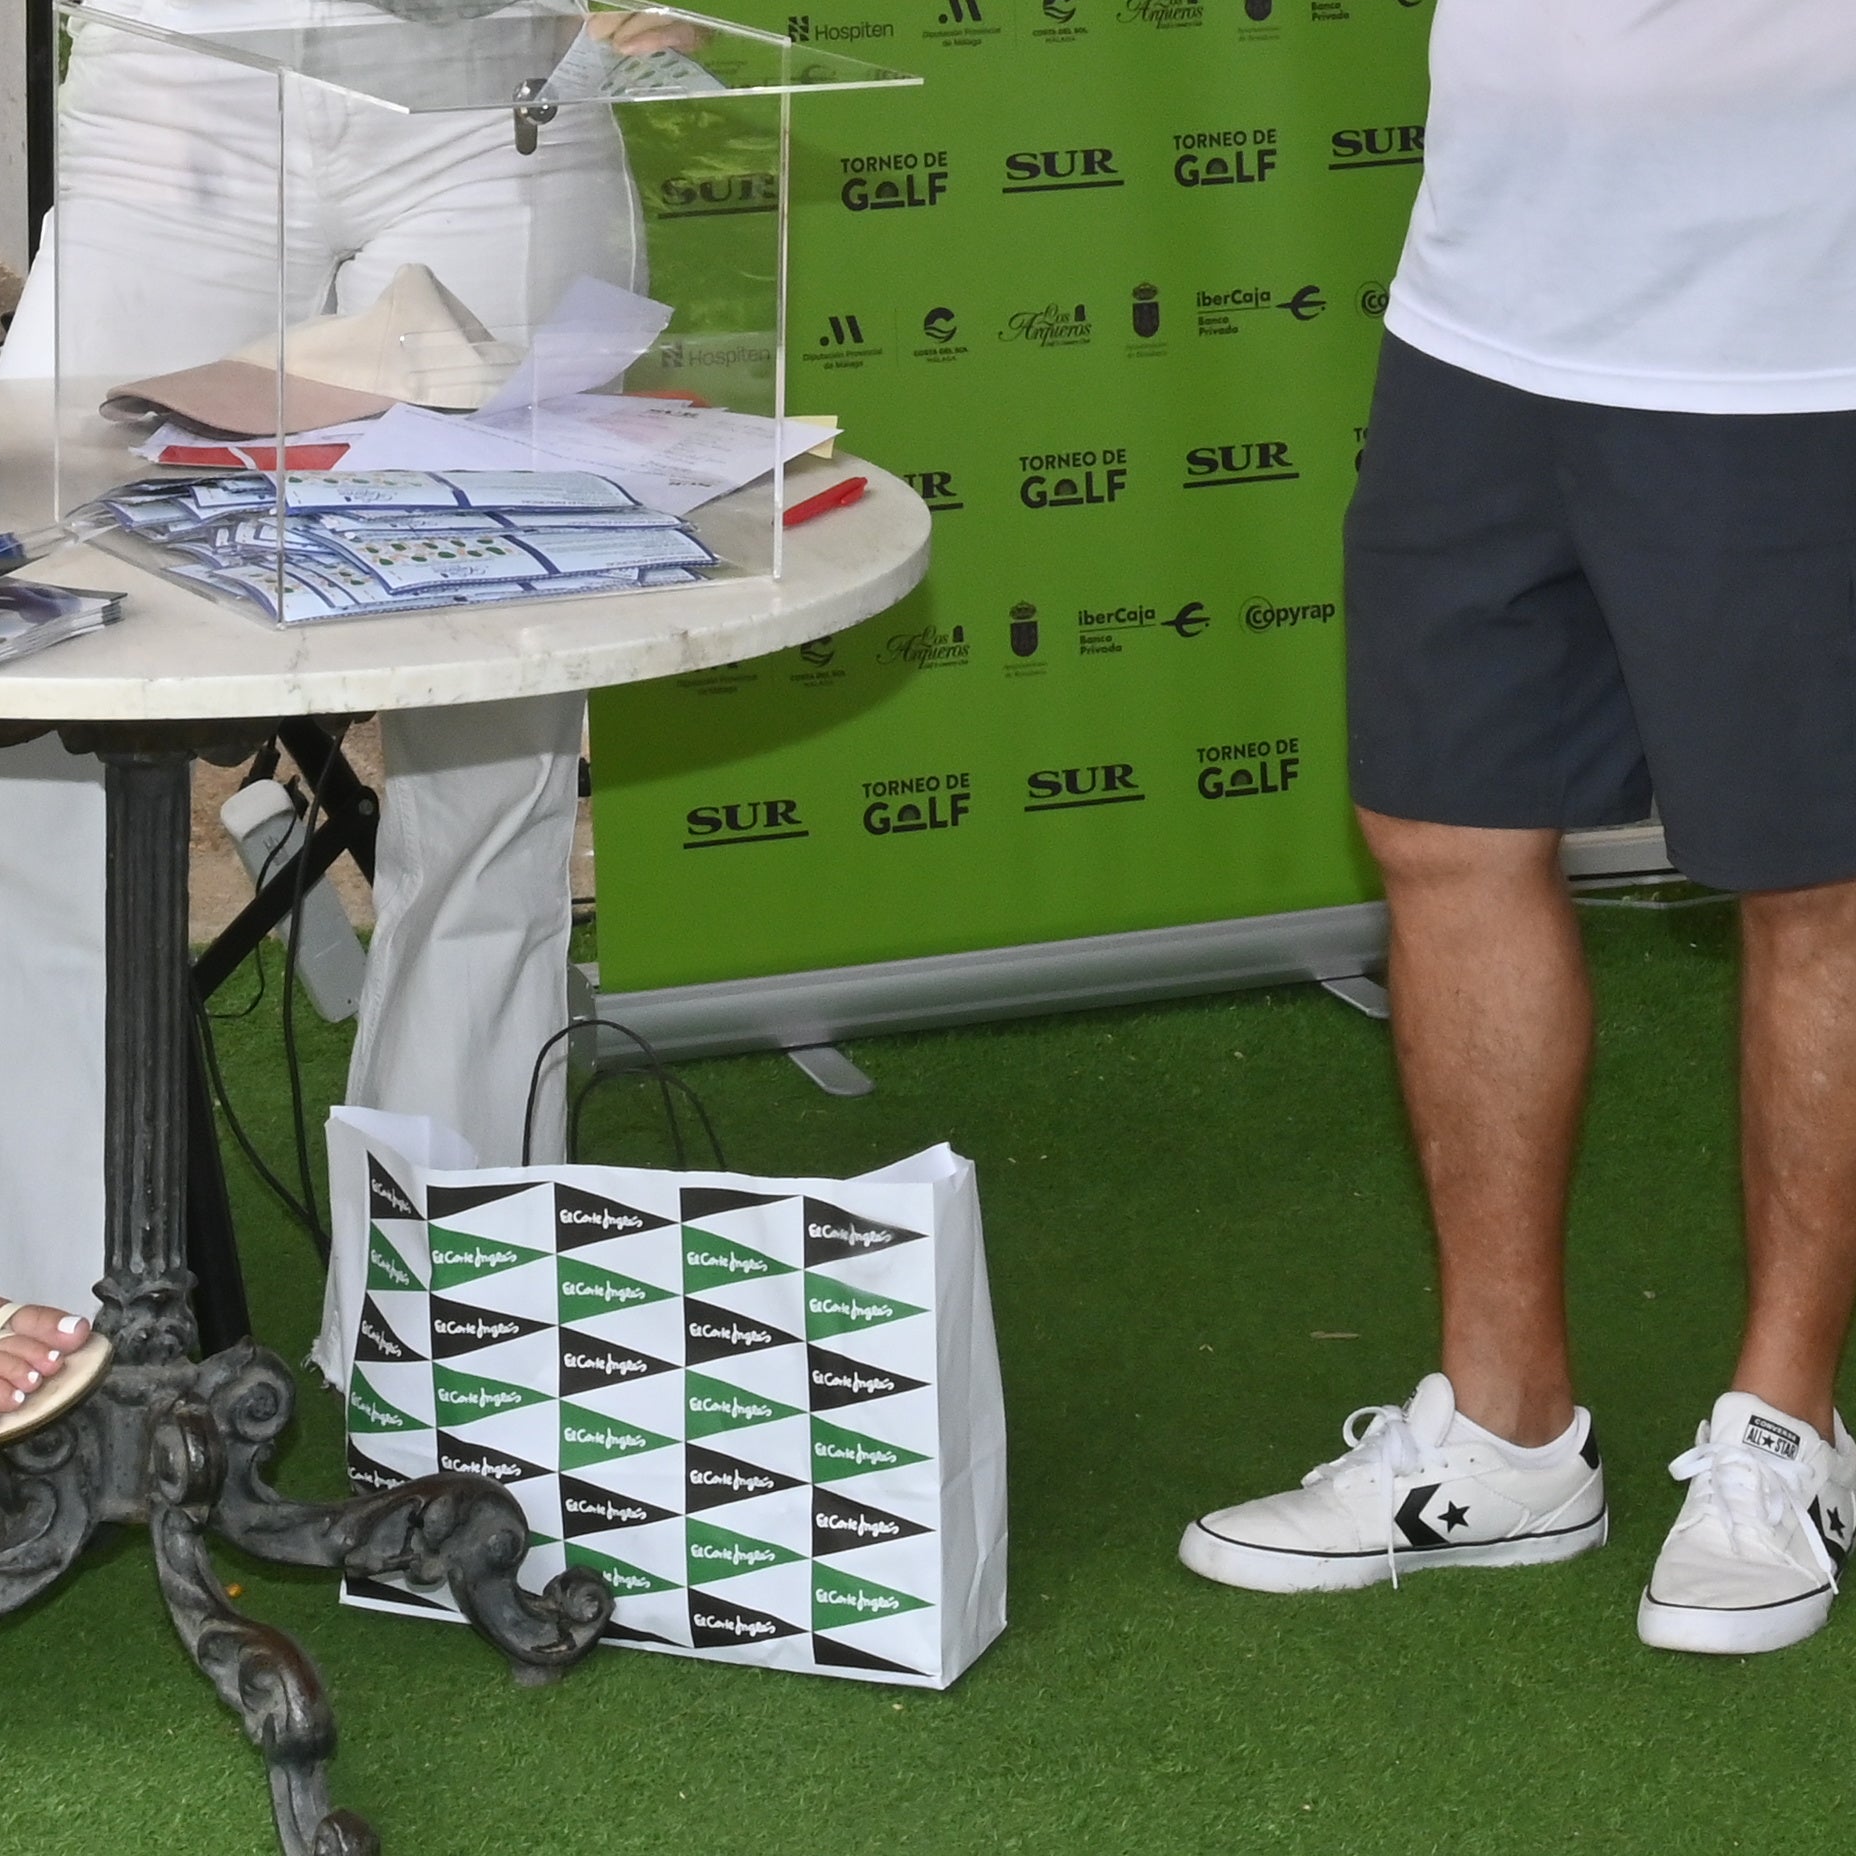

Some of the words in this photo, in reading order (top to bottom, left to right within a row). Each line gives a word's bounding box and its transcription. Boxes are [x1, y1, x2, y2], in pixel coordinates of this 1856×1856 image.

[814, 21, 894, 43] Hospiten
[1331, 124, 1425, 158] SUR
[839, 153, 918, 175] TORNEO
[923, 150, 948, 169] DE
[1005, 148, 1119, 181] SUR
[1018, 450, 1097, 473] TORNEO
[1102, 448, 1127, 466] DE
[1185, 441, 1294, 476] SUR
[1196, 740, 1272, 764] TORNEO
[1275, 737, 1299, 755] DE
[1027, 763, 1140, 799] SUR
[686, 799, 803, 836] SUR
[560, 1209, 571, 1223] El
[573, 1210, 601, 1224] Corte
[432, 1250, 444, 1264] El
[445, 1250, 474, 1264] Corte
[812, 1370, 824, 1384] El
[824, 1373, 852, 1388] Corte
[1746, 1427, 1763, 1443] ALL
[1774, 1439, 1796, 1459] STAR
[690, 1469, 703, 1484] El
[703, 1471, 733, 1485] Corte
[815, 1513, 829, 1528] El
[829, 1516, 858, 1531] Corte
